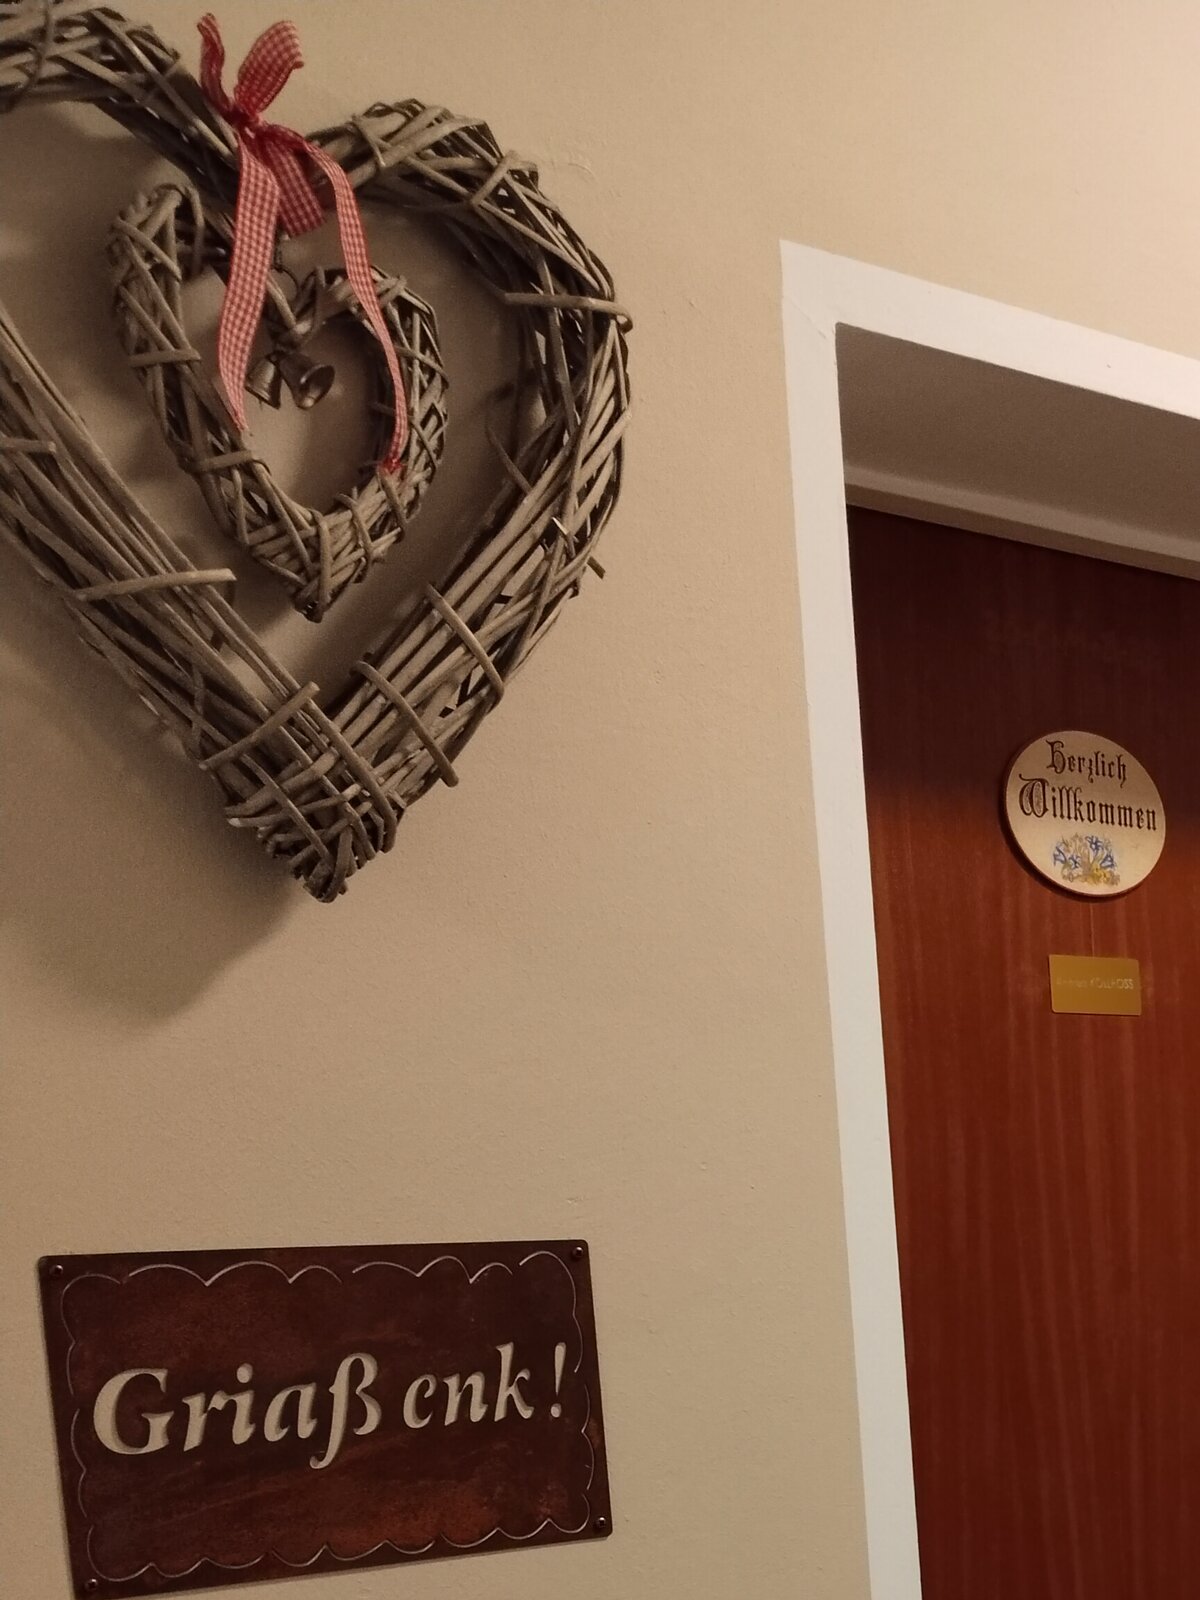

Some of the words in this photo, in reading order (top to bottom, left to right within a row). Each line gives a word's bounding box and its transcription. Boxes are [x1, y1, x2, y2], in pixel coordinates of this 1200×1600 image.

[1046, 739, 1127, 788] Herzlich
[1018, 773, 1157, 831] Willkommen
[92, 1353, 382, 1470] Griaß
